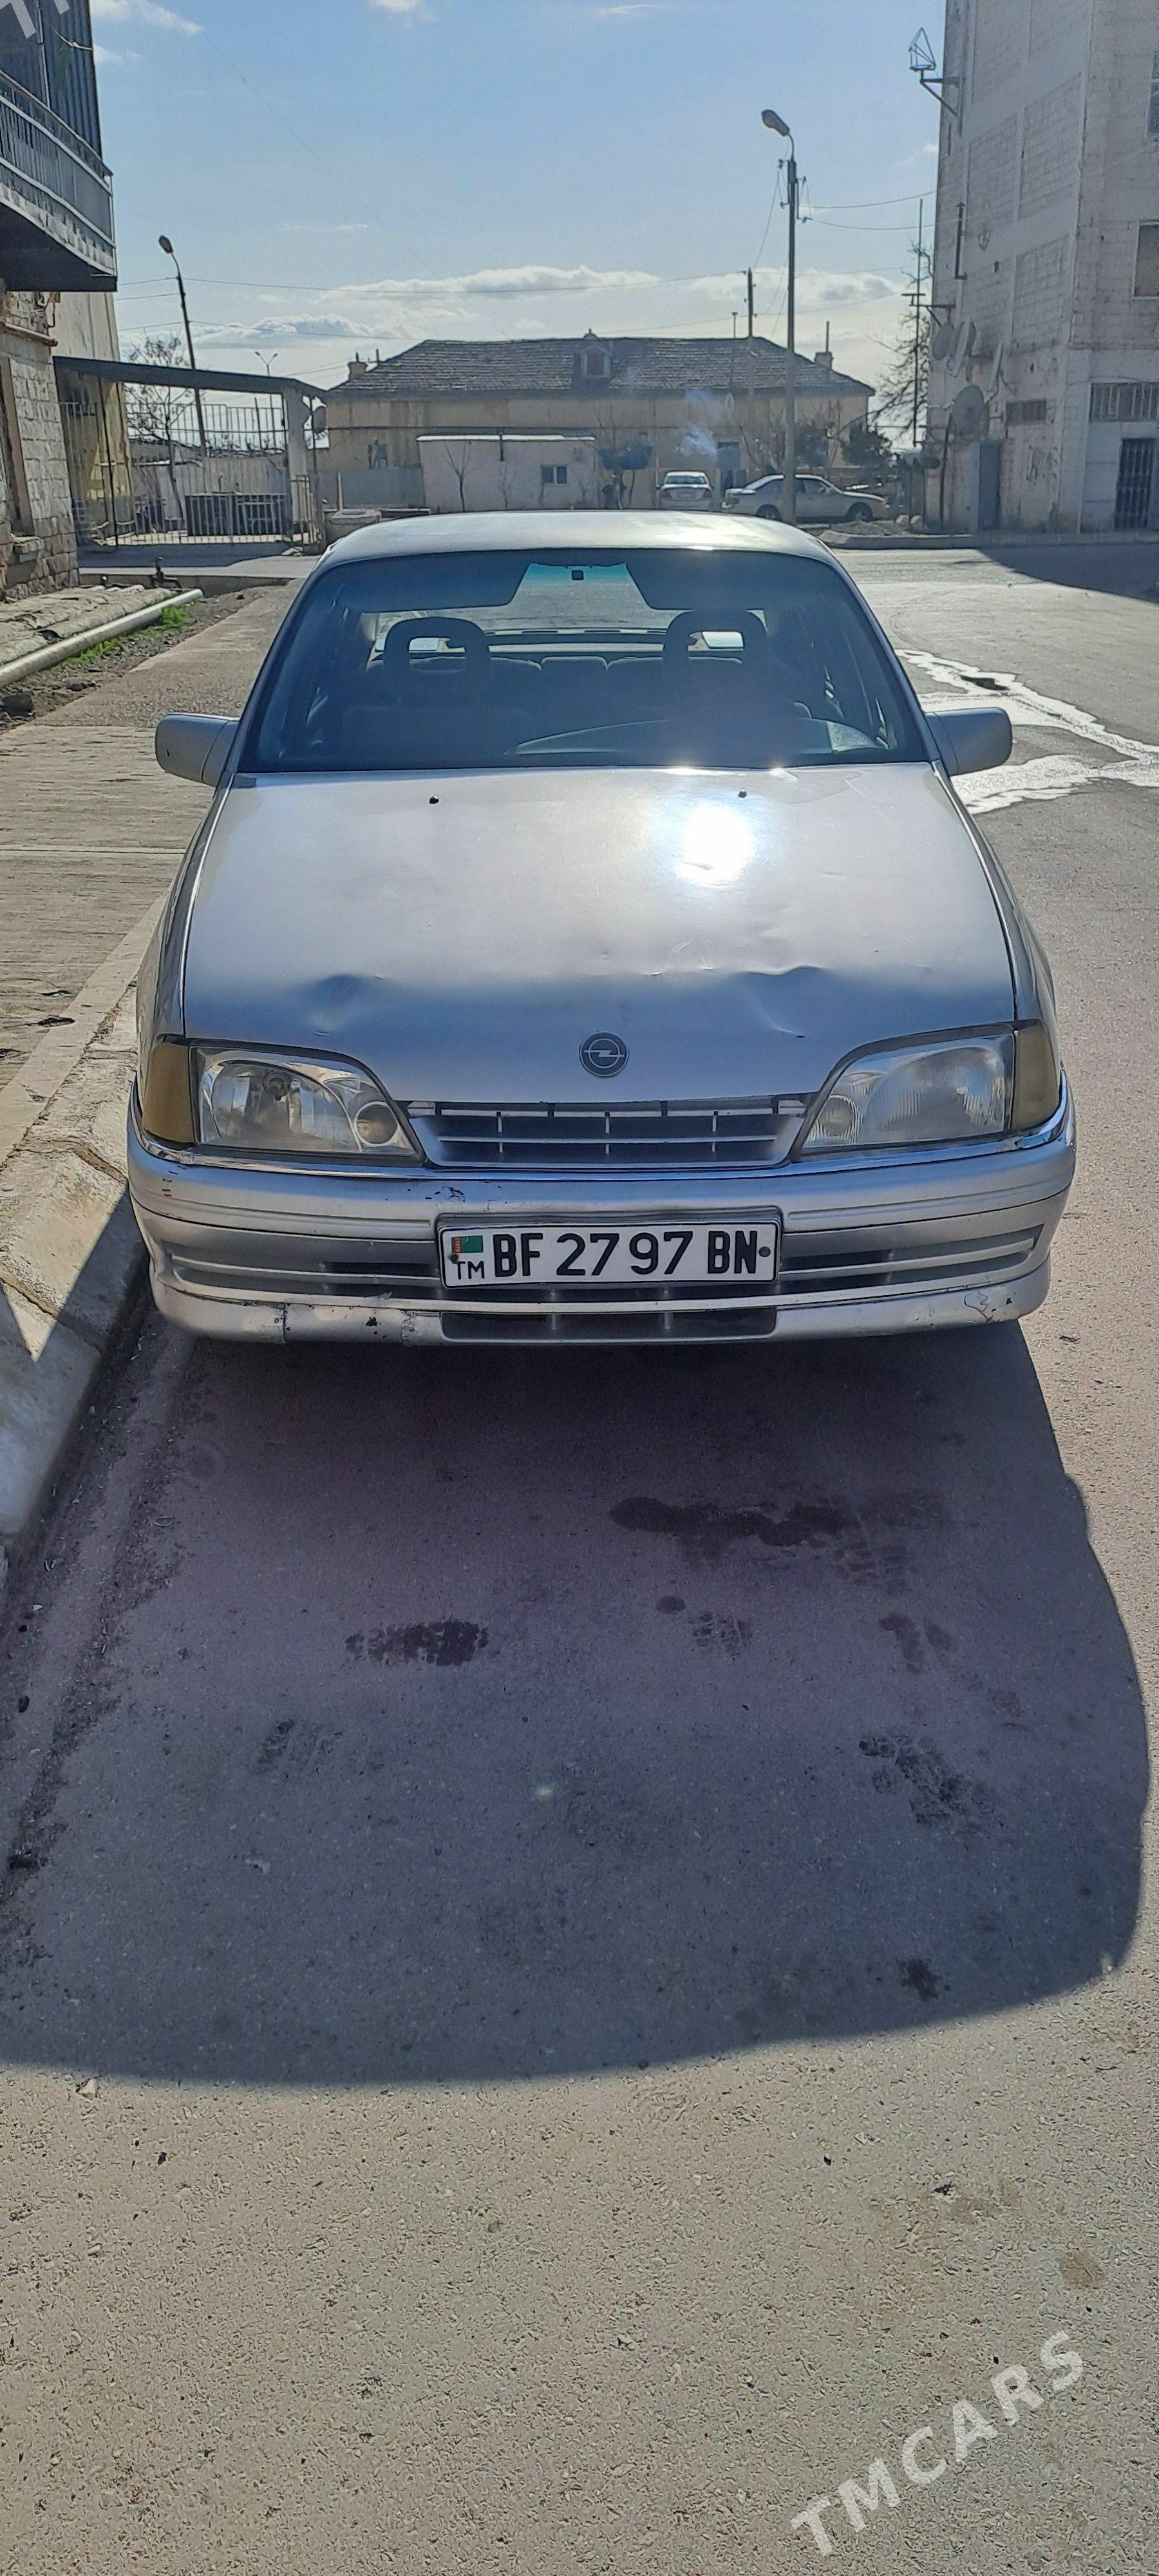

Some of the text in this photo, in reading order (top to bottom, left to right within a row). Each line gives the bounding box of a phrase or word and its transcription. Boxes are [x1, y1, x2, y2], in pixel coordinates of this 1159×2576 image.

[457, 1260, 485, 1280] TM
[493, 1233, 543, 1278] BF
[707, 1229, 758, 1274] BN
